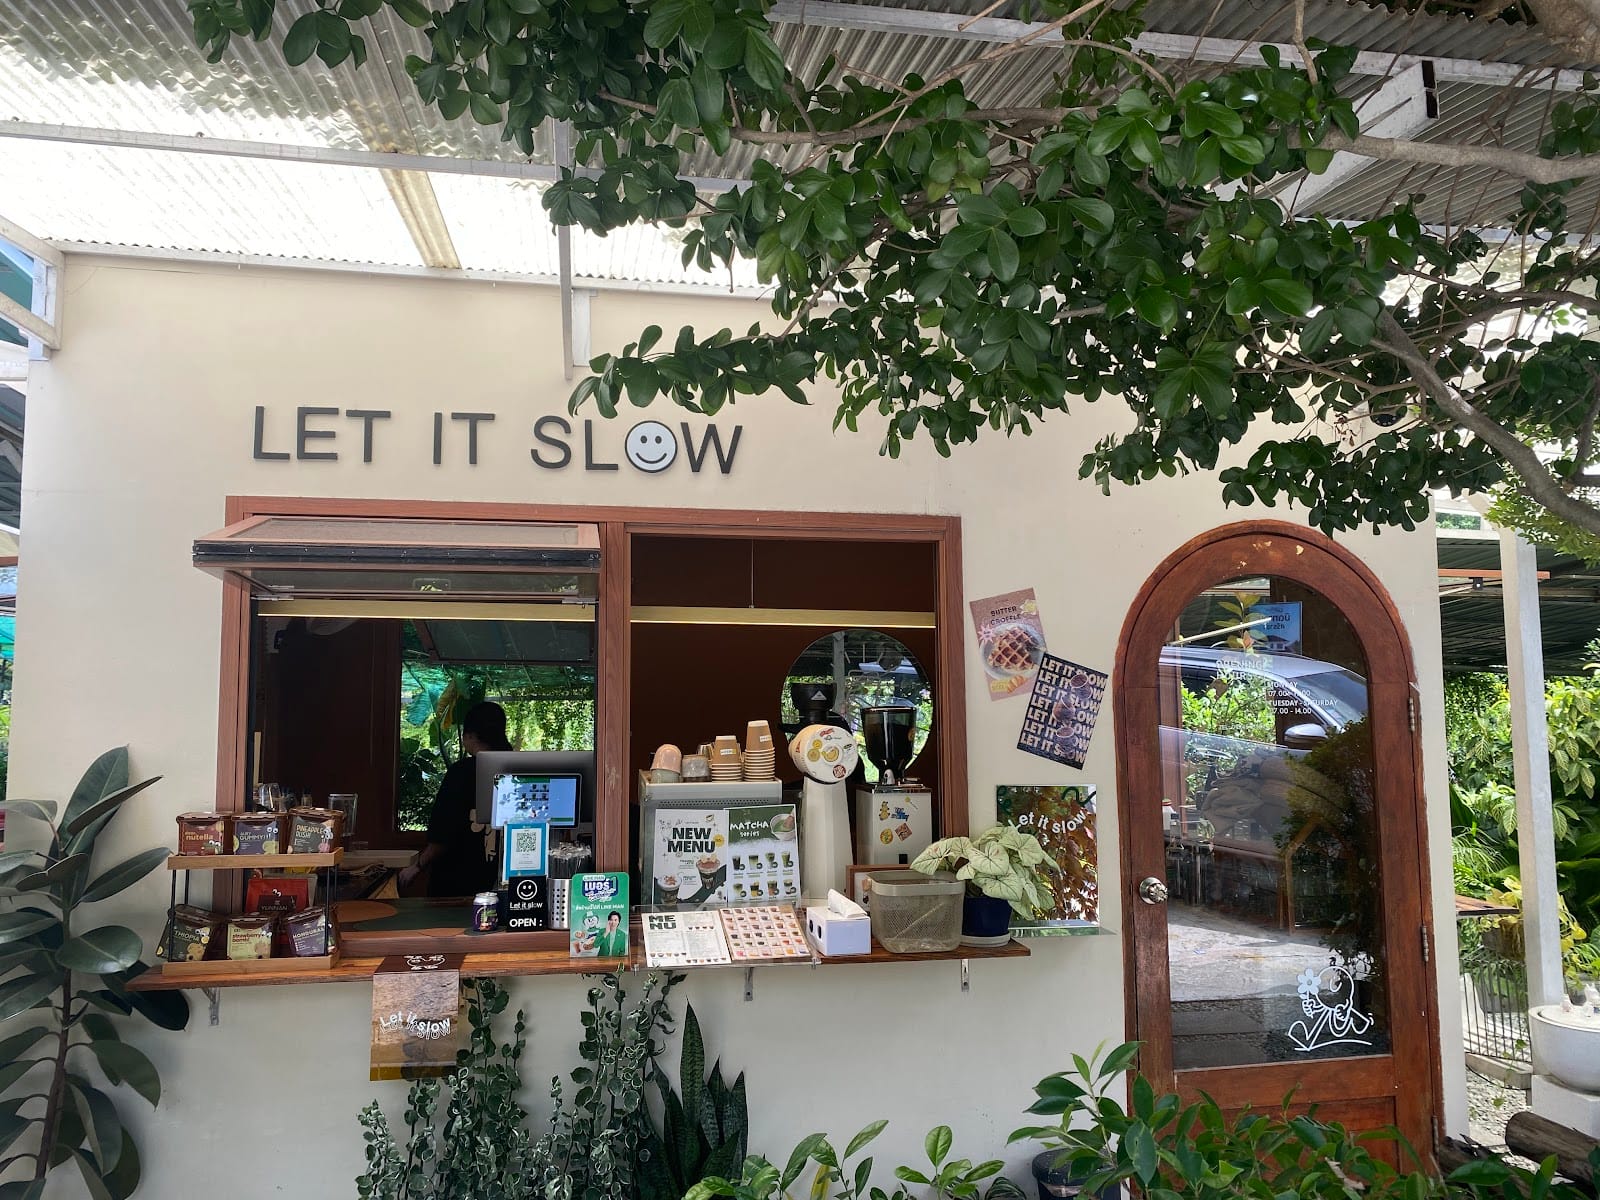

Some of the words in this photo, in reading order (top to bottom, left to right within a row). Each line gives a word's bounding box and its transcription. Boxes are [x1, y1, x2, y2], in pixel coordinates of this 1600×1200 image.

[253, 405, 392, 463] LET
[433, 411, 496, 465] IT
[990, 605, 1018, 617] BUTTER
[1042, 657, 1063, 675] LET
[1063, 663, 1076, 678] IT
[1038, 669, 1059, 686] LET
[1034, 681, 1056, 698] LET
[1030, 694, 1052, 711] LET
[1027, 706, 1050, 723] LET
[1024, 719, 1046, 736] LET
[1045, 726, 1057, 740] IT
[1020, 732, 1042, 749] LET
[1041, 739, 1054, 753] IT
[730, 820, 769, 830] MATCHA
[1038, 815, 1049, 830] it
[1052, 810, 1087, 834] slow
[186, 833, 214, 841] nutella
[672, 827, 712, 840] NEW
[667, 840, 716, 853] MENU
[509, 918, 537, 928] OPEN
[649, 914, 676, 923] ME
[649, 922, 677, 930] NU
[174, 930, 201, 942] THIOPIA
[380, 1011, 402, 1028] Let
[407, 1011, 418, 1024] it
[417, 1017, 451, 1032] slow
